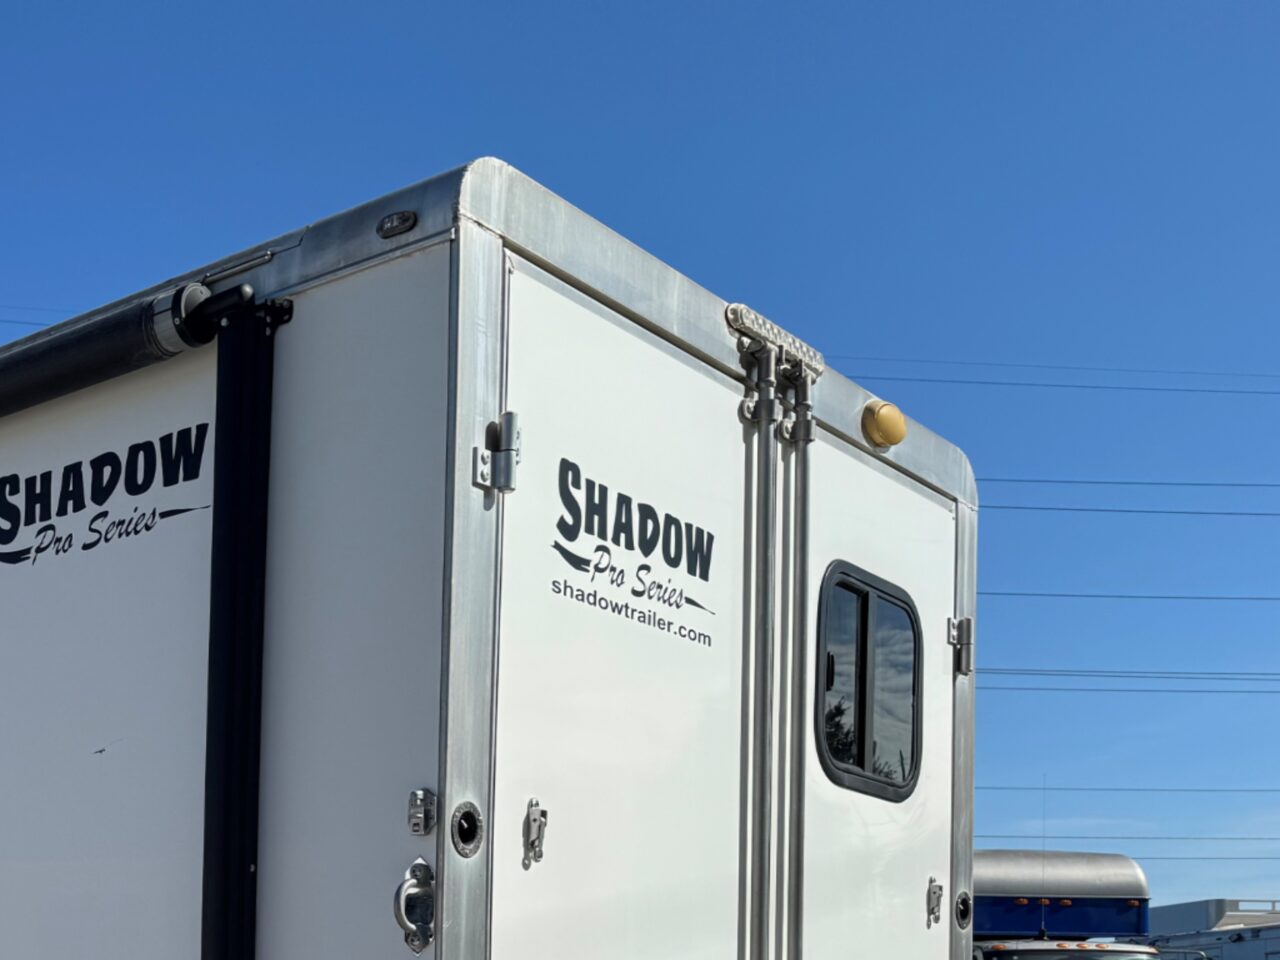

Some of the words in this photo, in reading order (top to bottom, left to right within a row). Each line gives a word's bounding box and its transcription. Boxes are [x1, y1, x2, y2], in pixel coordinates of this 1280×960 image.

[31, 524, 74, 566] Pro
[81, 506, 158, 551] Series
[556, 457, 715, 582] SHADOW
[591, 545, 625, 587] Pro
[631, 563, 686, 609] Series
[551, 579, 713, 647] shadowtrailer.com
